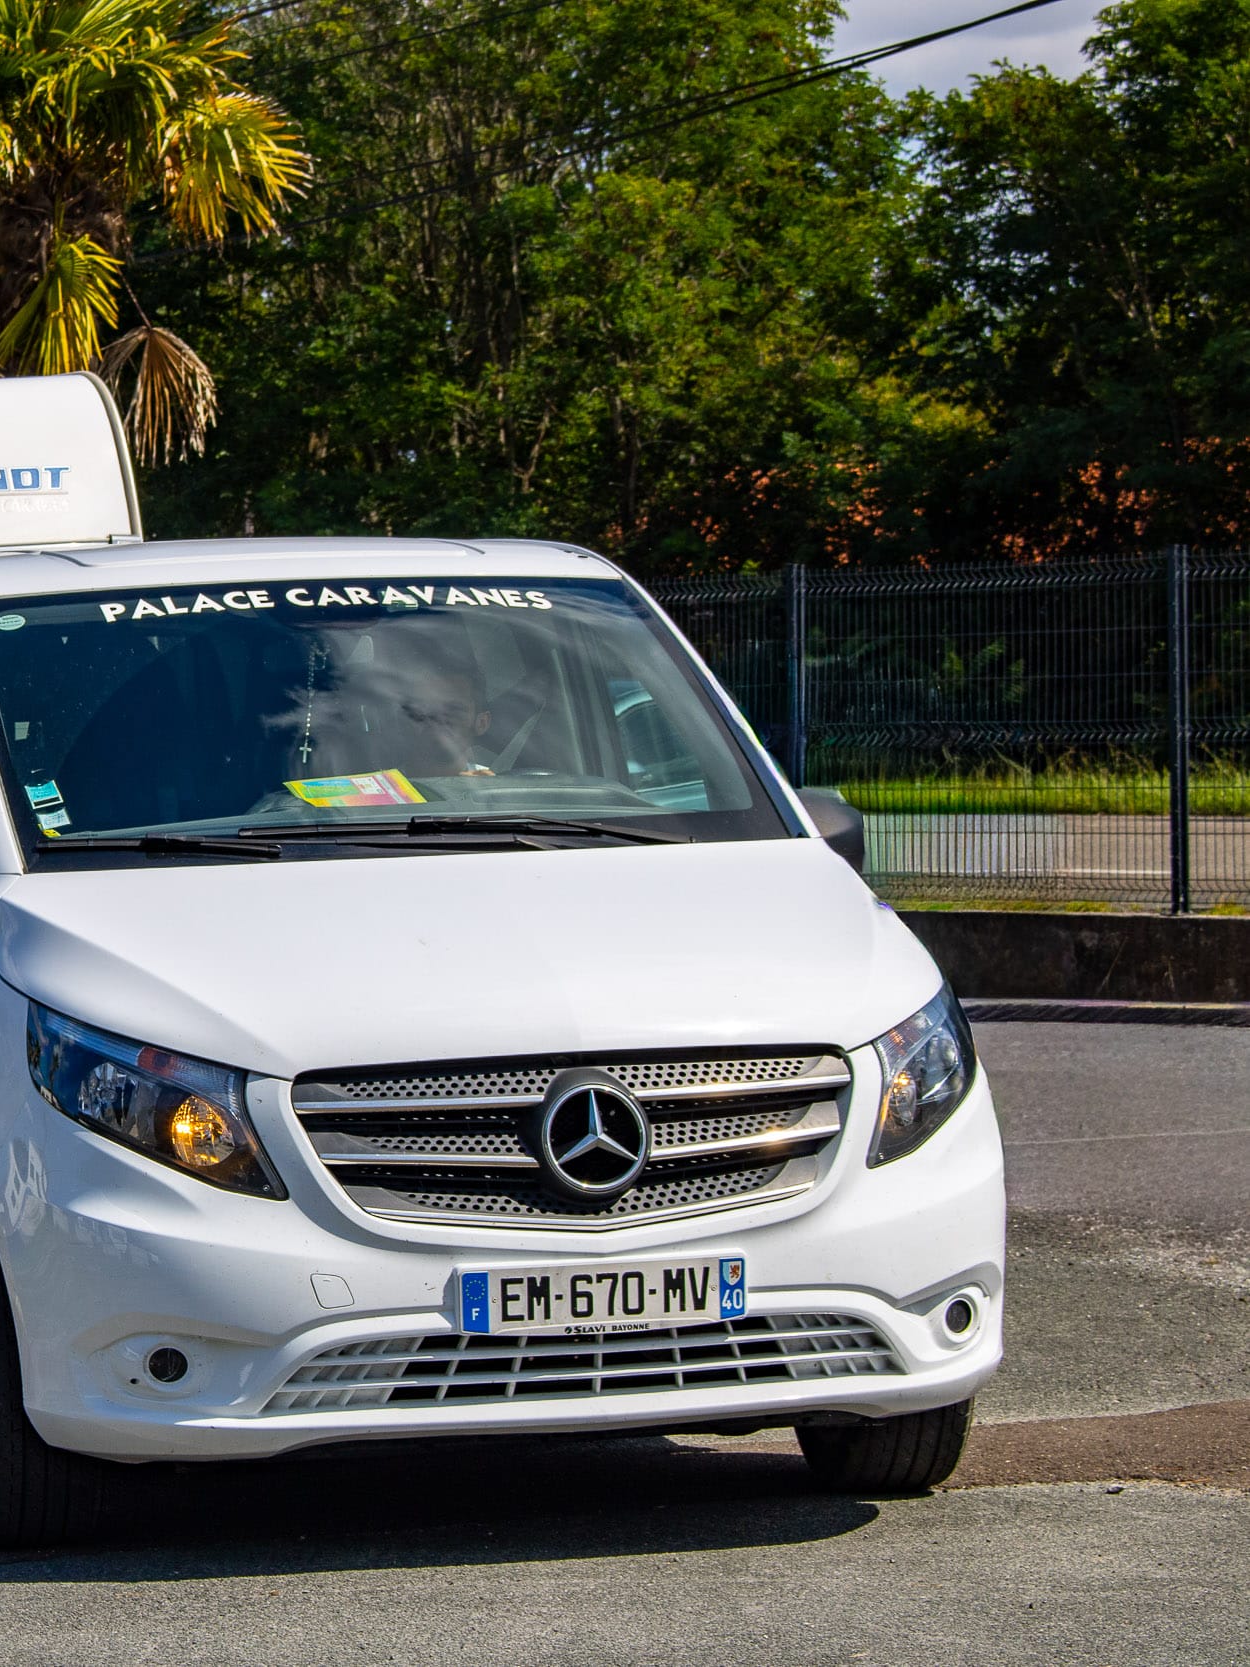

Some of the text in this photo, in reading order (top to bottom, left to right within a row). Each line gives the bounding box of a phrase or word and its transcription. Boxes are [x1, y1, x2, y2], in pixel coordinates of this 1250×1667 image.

[100, 586, 553, 623] PALACE CARAVANES
[500, 1266, 711, 1322] EM-670-MV
[721, 1288, 744, 1310] 40
[471, 1308, 481, 1321] F
[611, 1323, 651, 1332] BAYONNE
